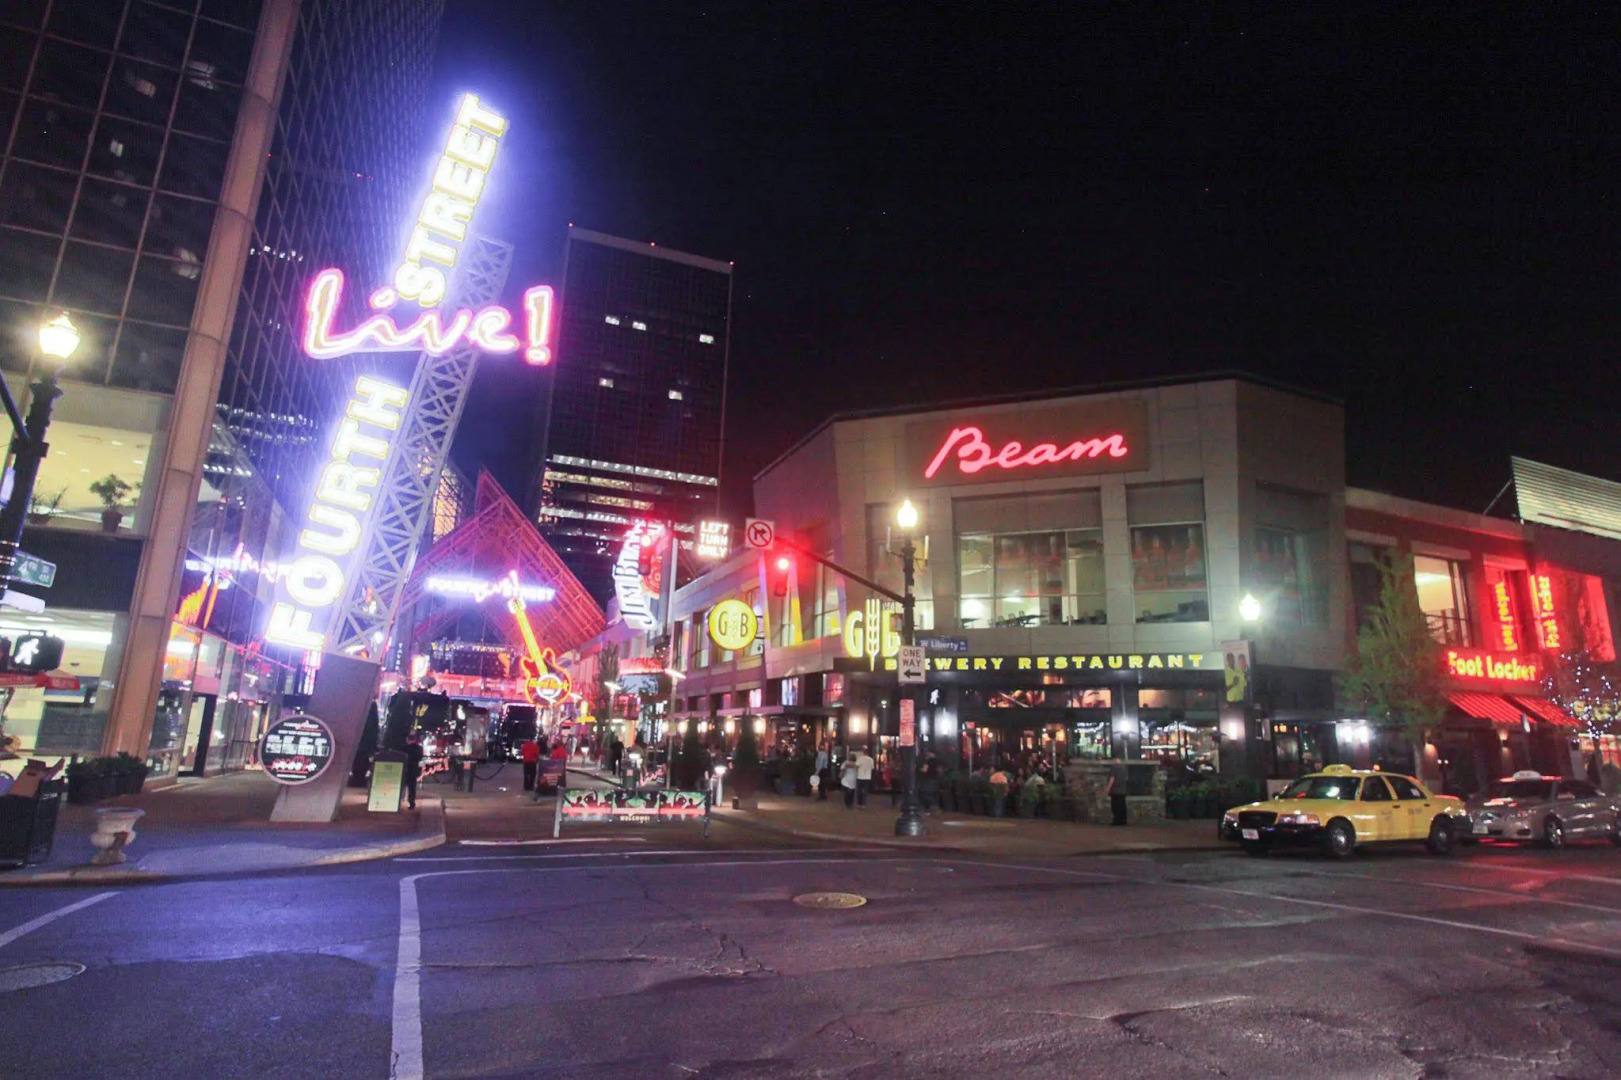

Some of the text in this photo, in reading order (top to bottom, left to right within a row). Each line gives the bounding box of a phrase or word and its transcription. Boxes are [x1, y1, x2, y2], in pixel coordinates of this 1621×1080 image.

[395, 92, 510, 308] STREET
[304, 268, 554, 365] Live!
[925, 426, 1128, 479] Beam
[264, 374, 408, 652] FOURTH
[701, 521, 729, 534] LEFT
[700, 534, 729, 546] TURN
[698, 545, 728, 558] ONLY
[718, 610, 749, 637] G B
[844, 610, 863, 658] G
[902, 649, 921, 657] ONE
[930, 639, 959, 651] Liberty
[884, 654, 1204, 671] BEWERY RESTAURANT
[902, 659, 921, 668] WAY
[1448, 651, 1537, 681] Foot Locker
